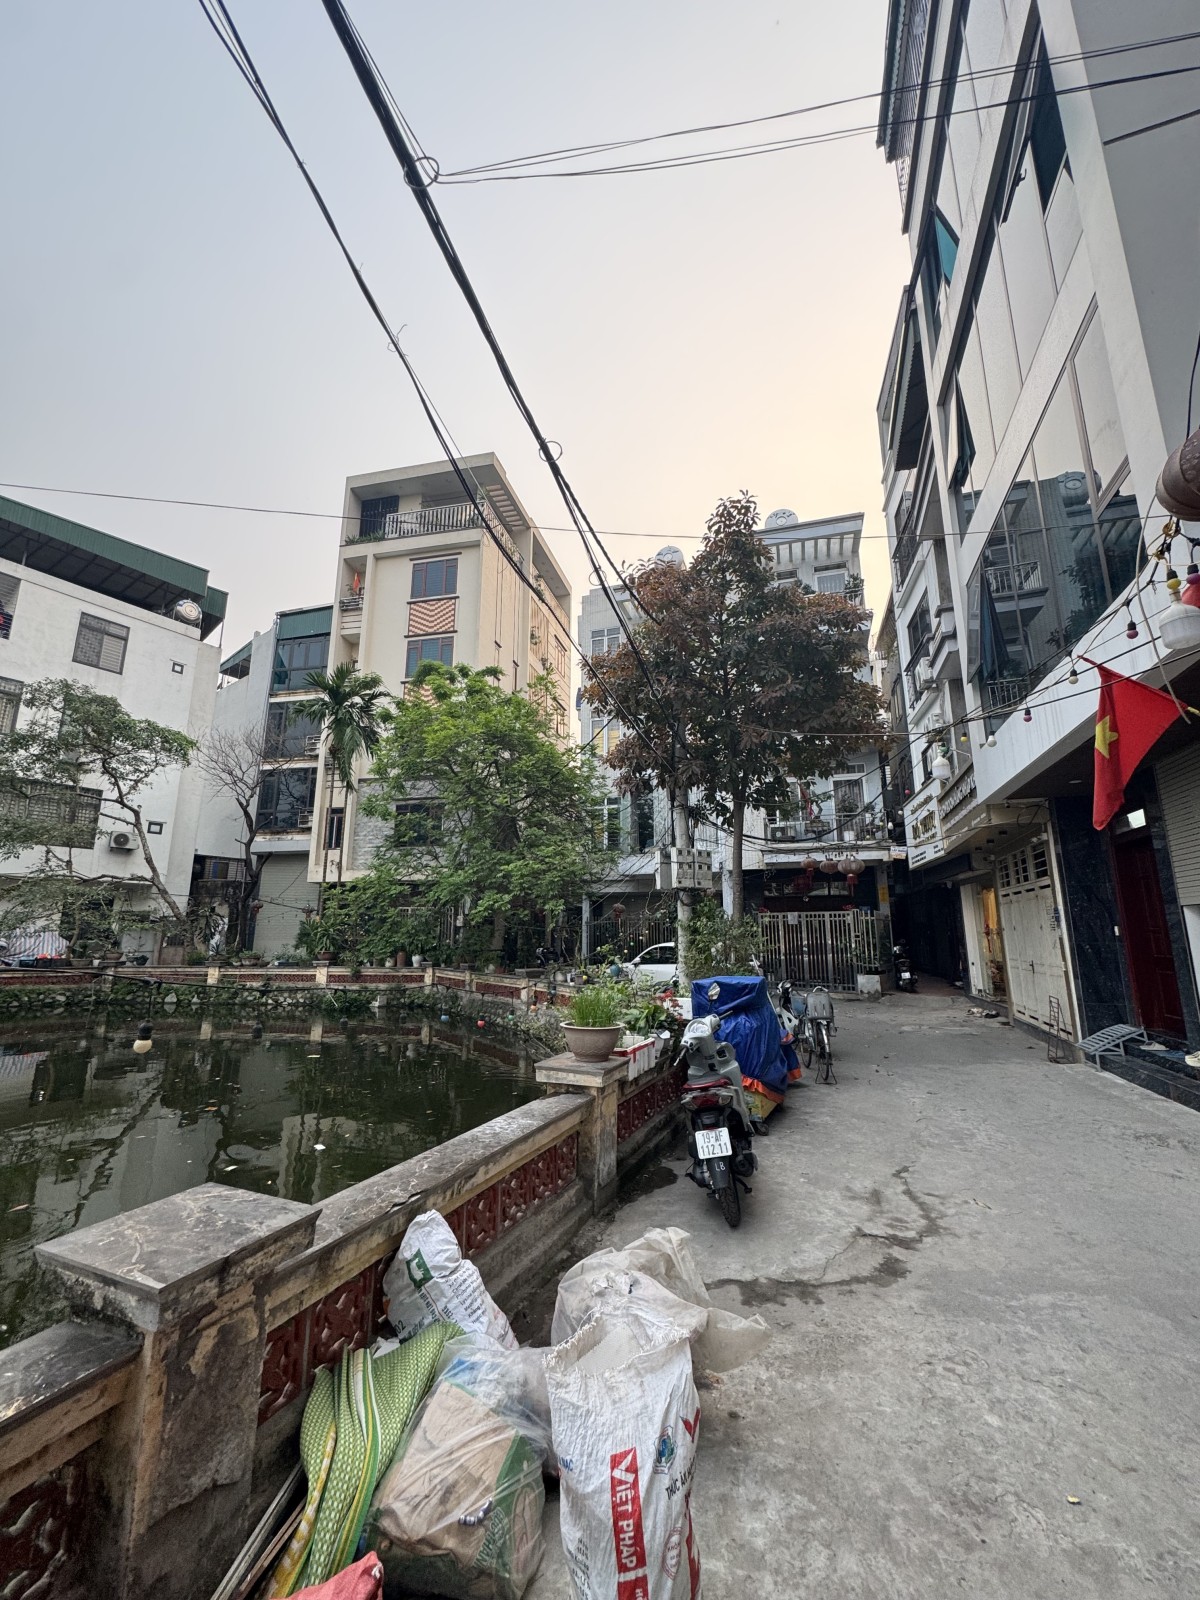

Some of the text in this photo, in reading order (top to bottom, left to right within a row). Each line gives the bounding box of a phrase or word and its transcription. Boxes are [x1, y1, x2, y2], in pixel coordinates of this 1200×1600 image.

[701, 1130, 723, 1144] 19-AF
[701, 1142, 729, 1157] 112.11
[618, 1521, 640, 1568] PHÁP
